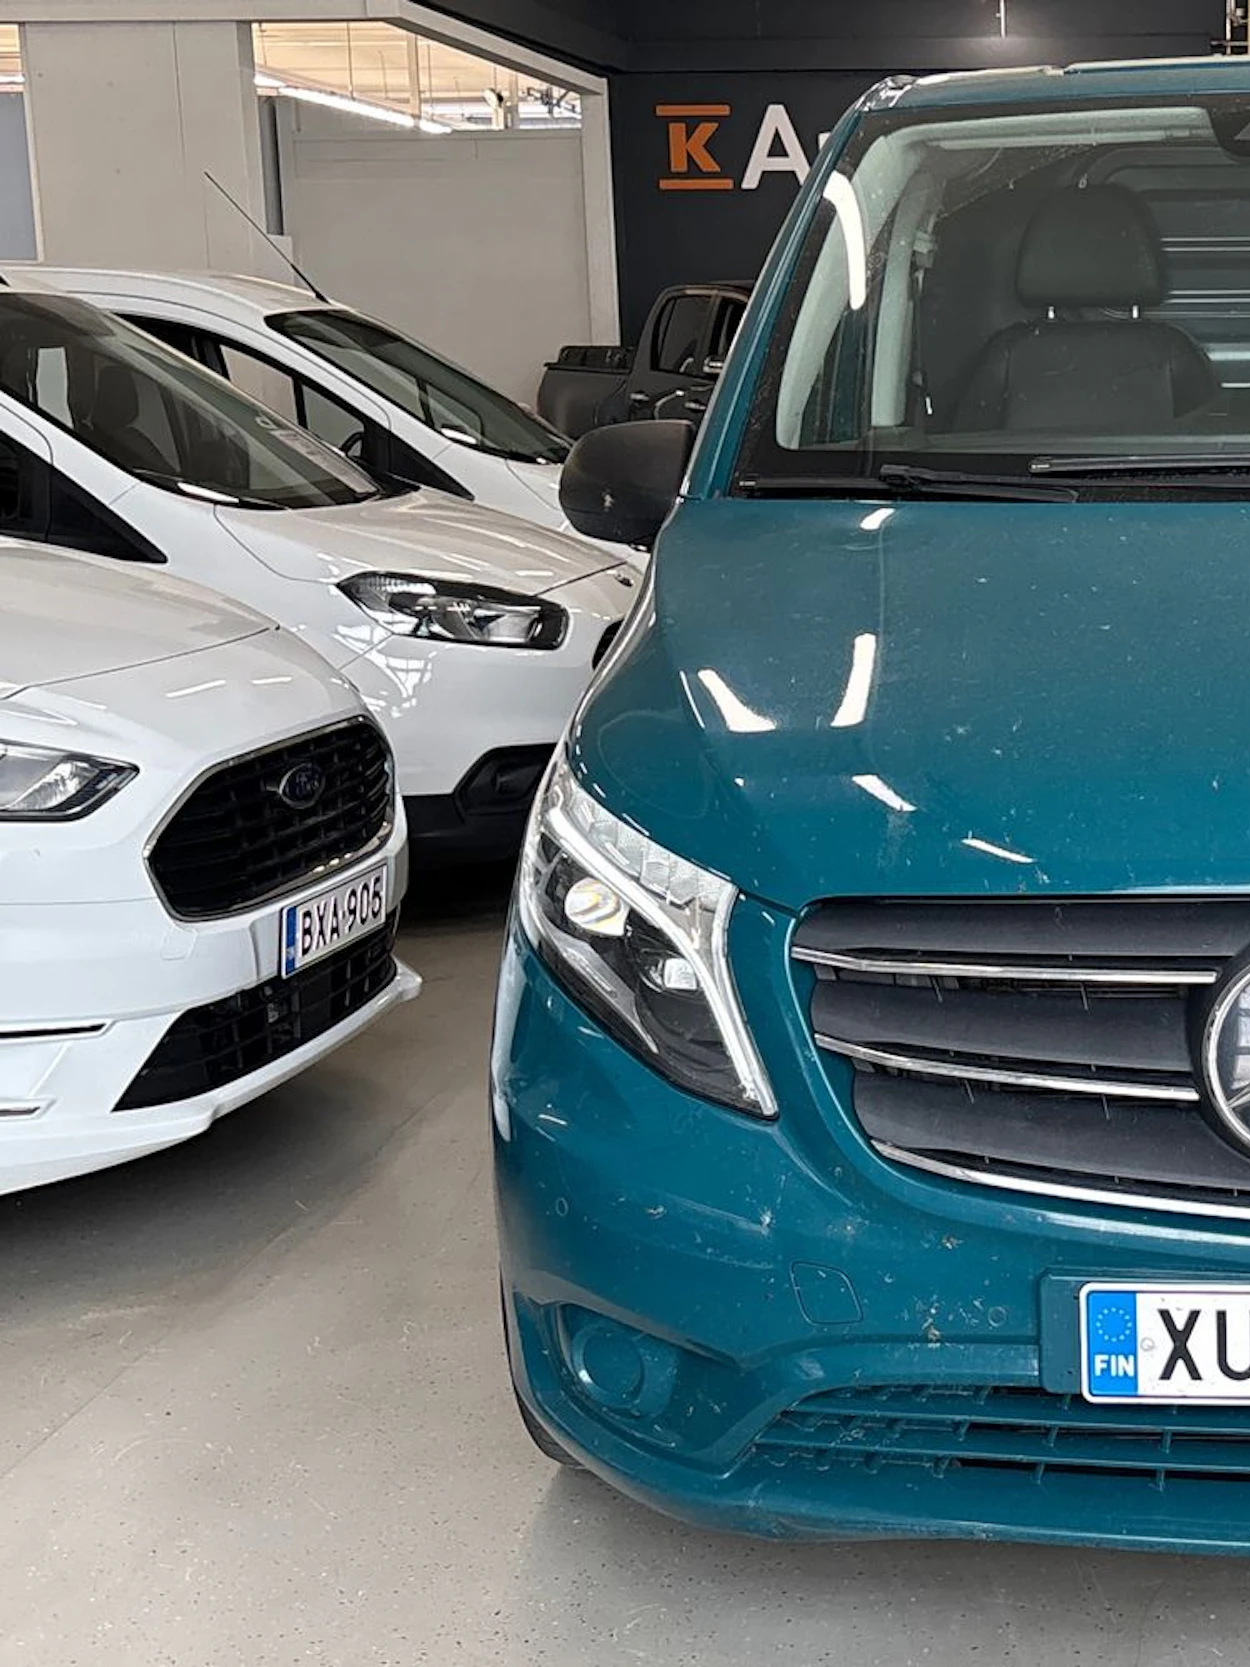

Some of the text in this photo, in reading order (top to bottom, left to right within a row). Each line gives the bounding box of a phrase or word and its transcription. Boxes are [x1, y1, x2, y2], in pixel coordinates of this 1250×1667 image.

[741, 104, 832, 190] A
[302, 875, 382, 957] BXA-905
[1094, 1354, 1135, 1377] FIN
